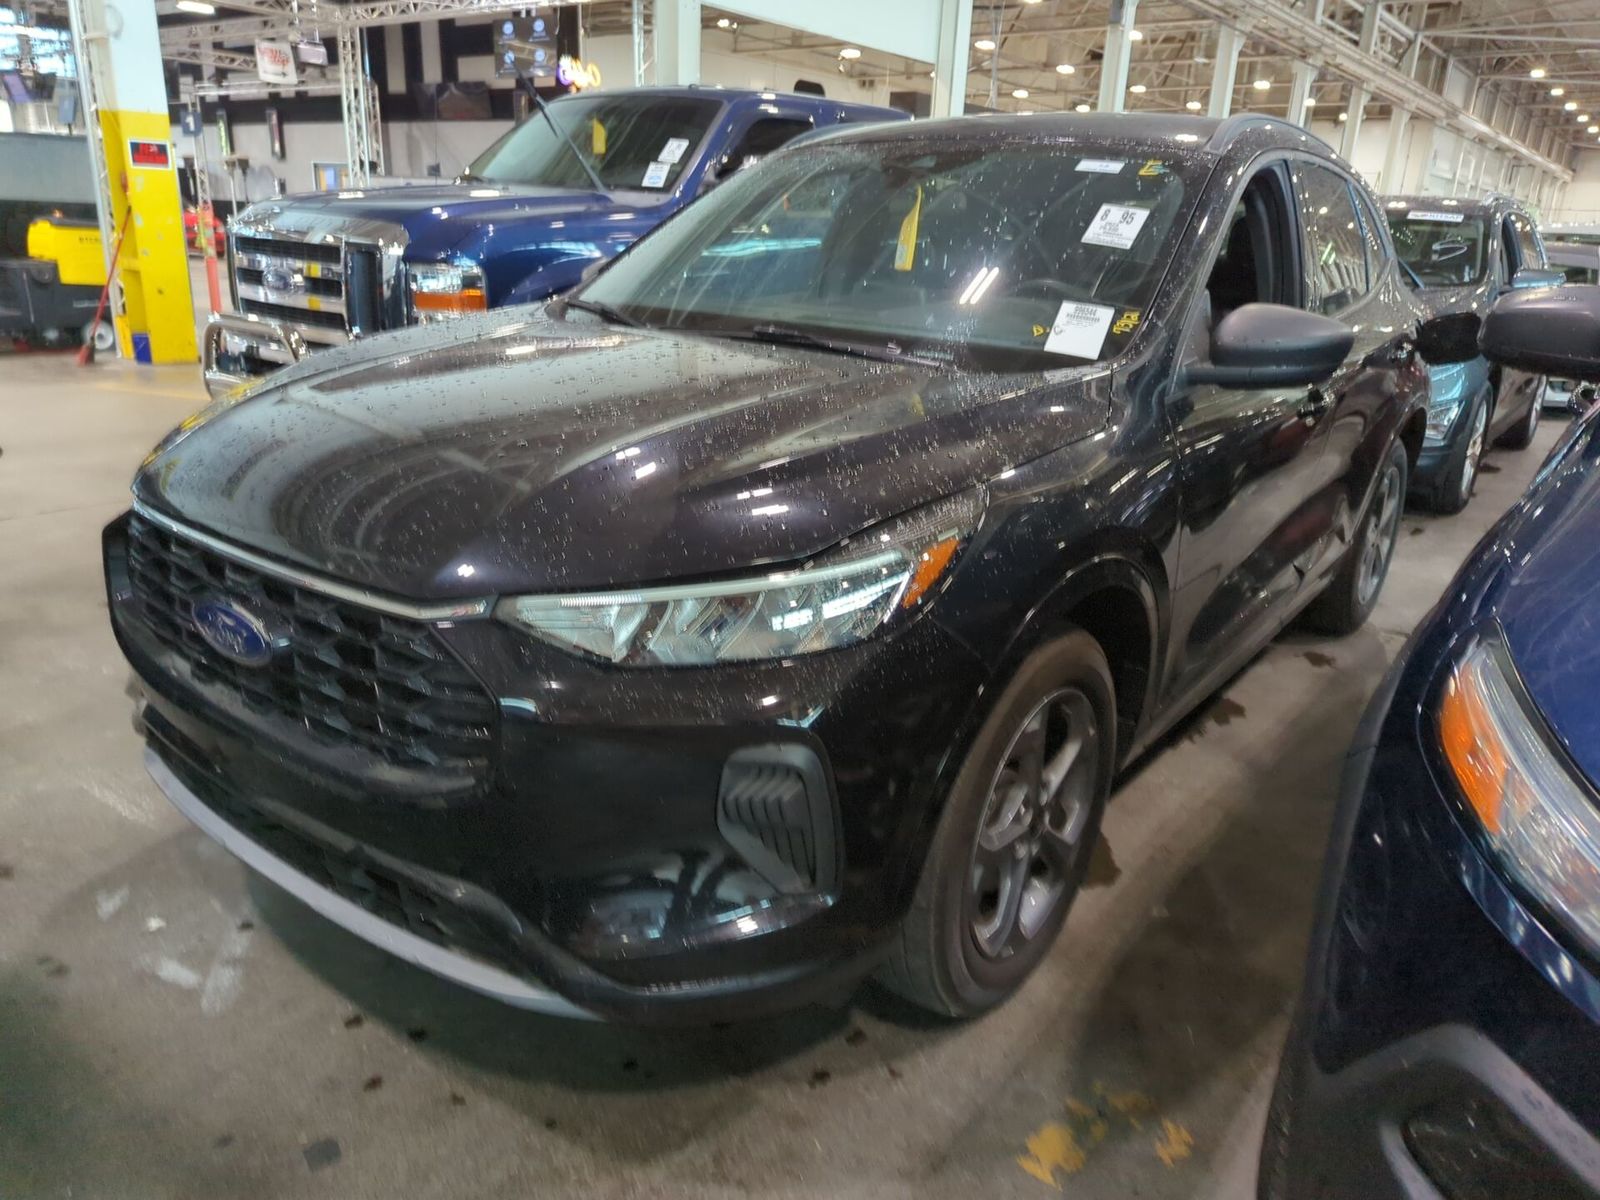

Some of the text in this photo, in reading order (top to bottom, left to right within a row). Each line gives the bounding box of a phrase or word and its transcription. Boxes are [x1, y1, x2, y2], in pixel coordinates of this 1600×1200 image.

[185, 114, 195, 131] 1
[1100, 208, 1136, 225] 8 95
